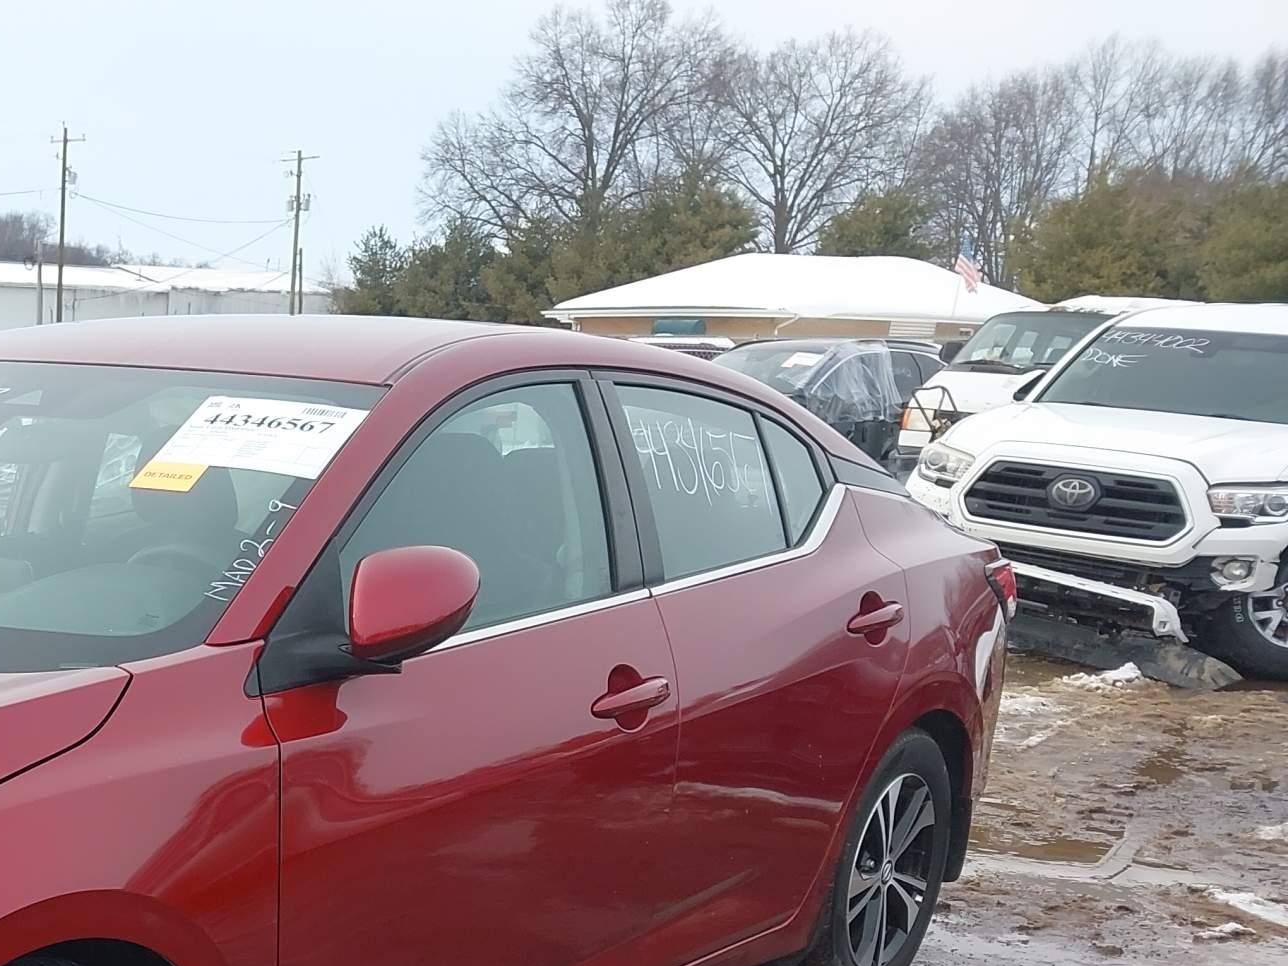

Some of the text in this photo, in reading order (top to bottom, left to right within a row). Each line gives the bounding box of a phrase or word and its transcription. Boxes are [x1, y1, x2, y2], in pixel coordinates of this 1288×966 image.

[1101, 329, 1211, 354] 44344002
[1081, 347, 1150, 368] DONE
[203, 412, 336, 434] 44346567
[143, 470, 194, 481] DETAILED
